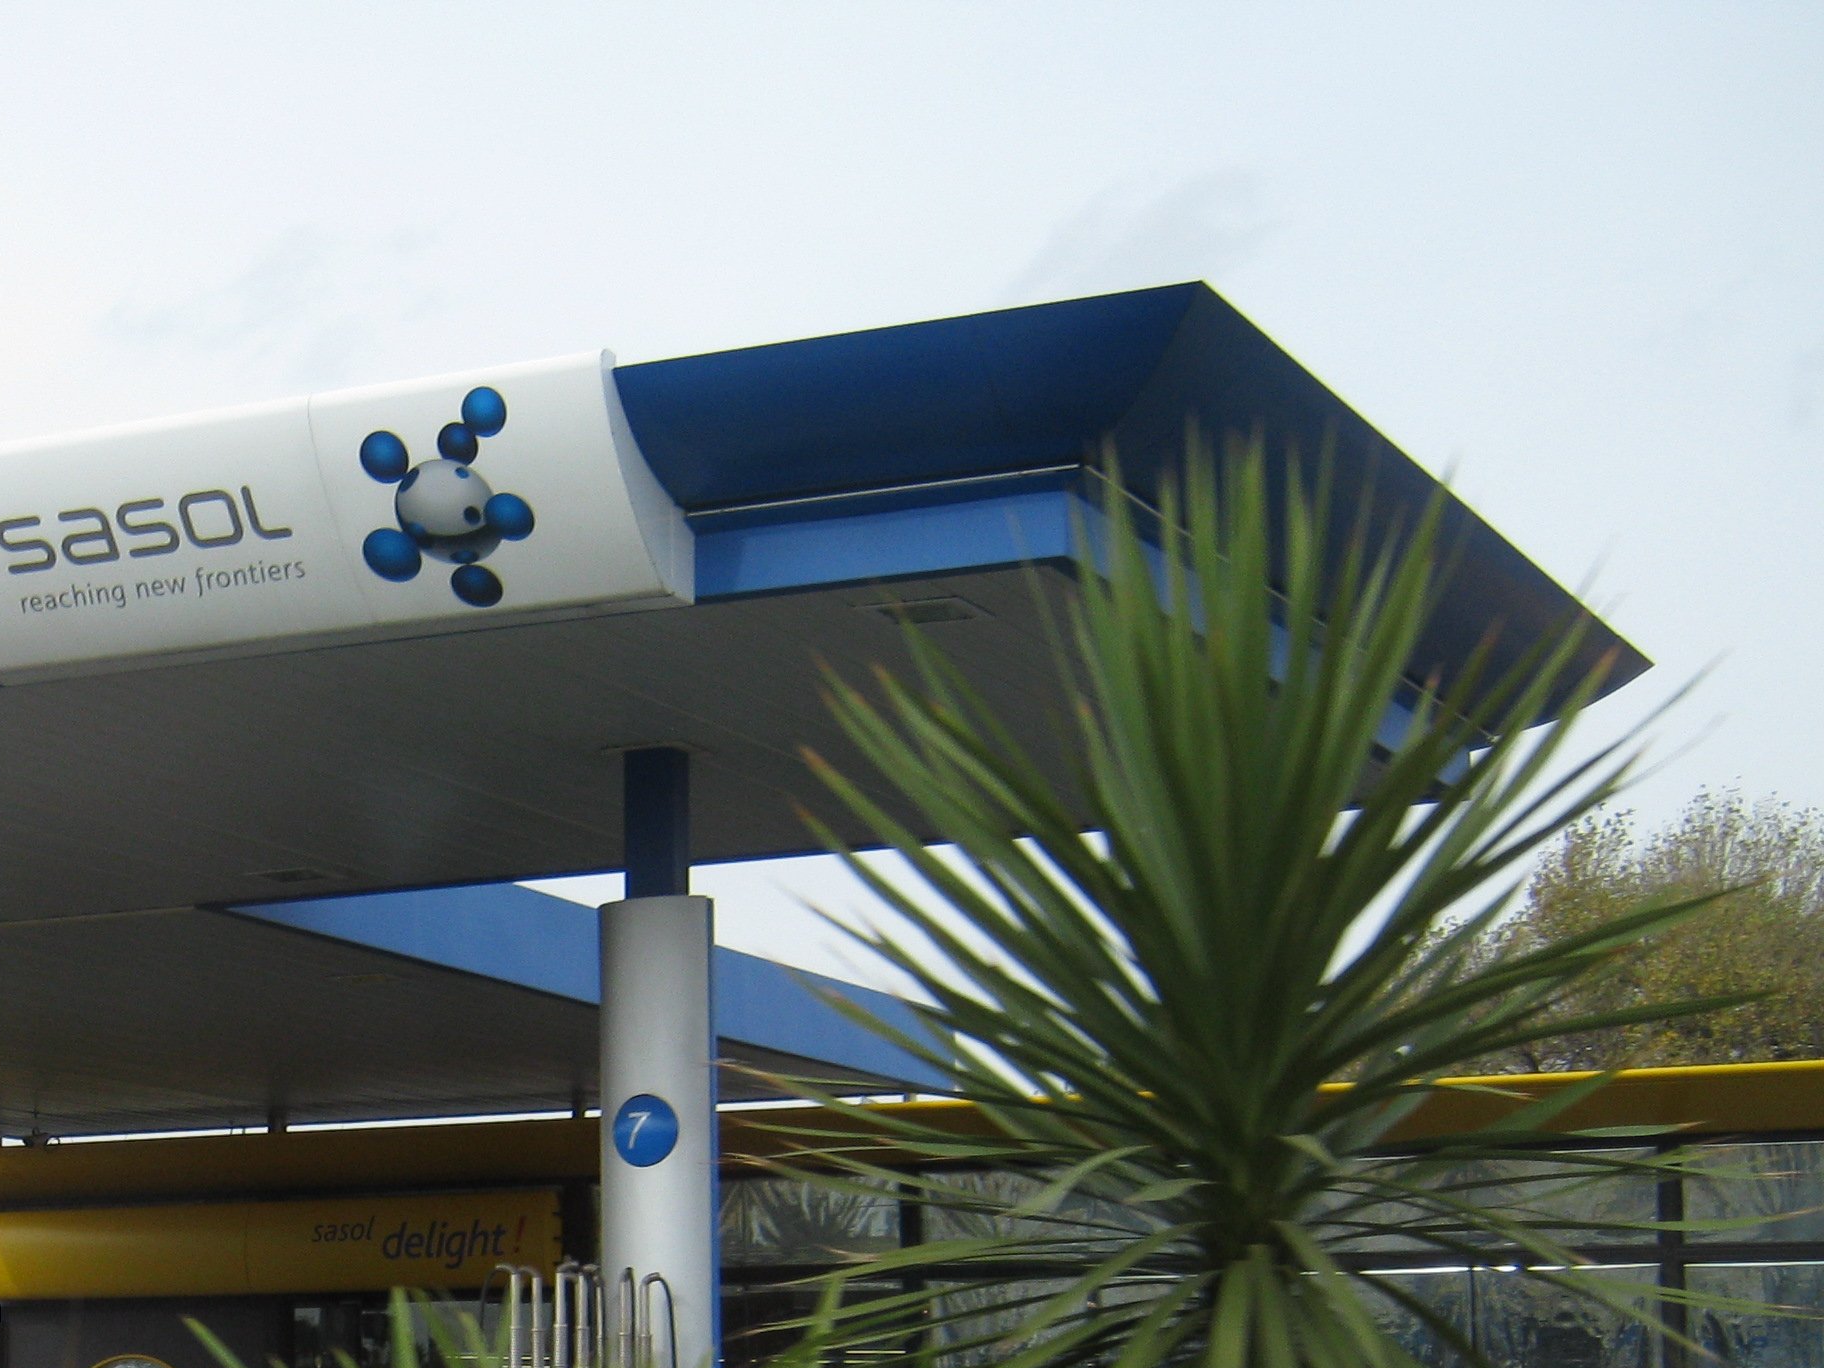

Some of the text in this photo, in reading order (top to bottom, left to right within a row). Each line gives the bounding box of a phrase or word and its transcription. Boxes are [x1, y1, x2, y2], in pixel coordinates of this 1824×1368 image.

[19, 558, 306, 615] reaching new frontiers
[628, 1111, 651, 1149] 7
[311, 1215, 375, 1242] sasol
